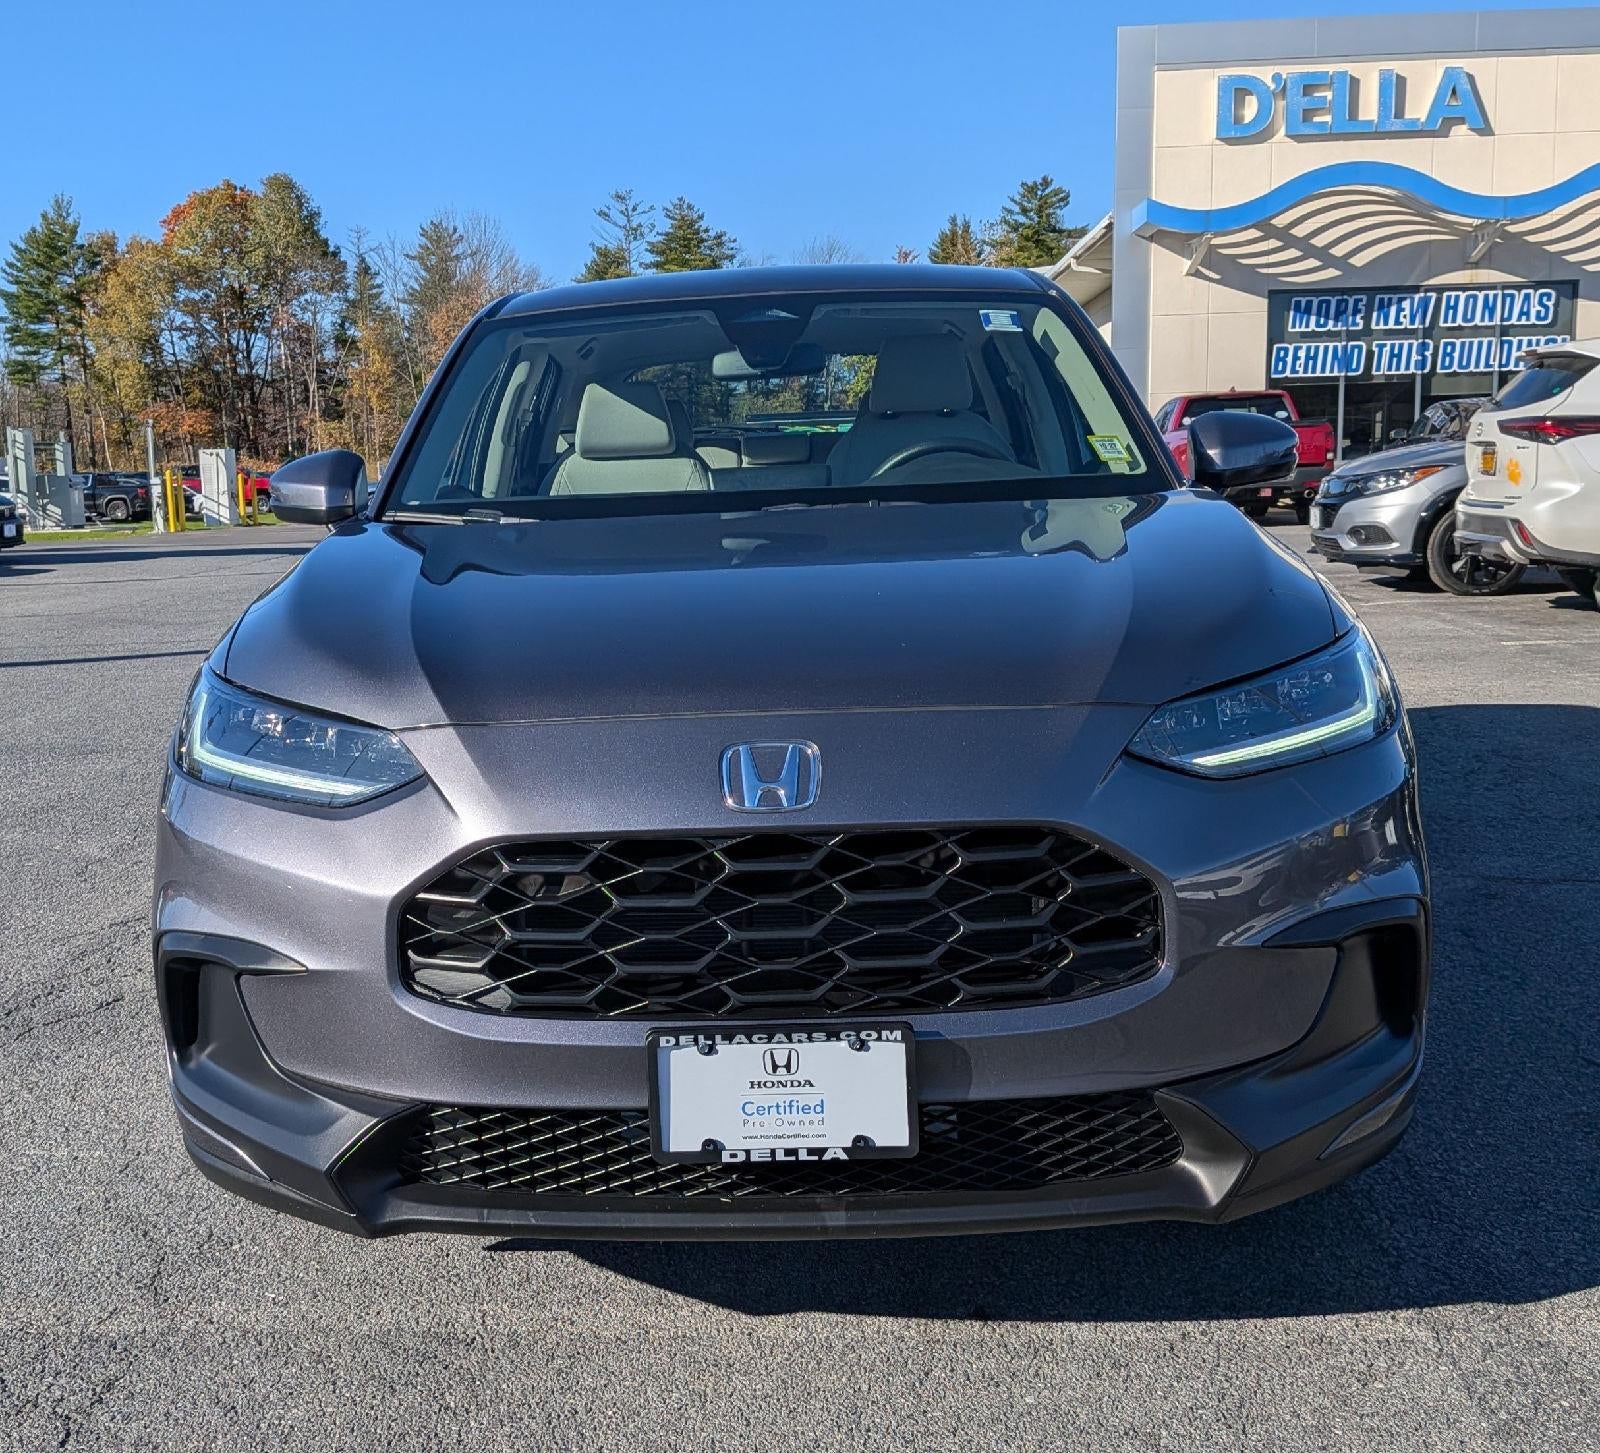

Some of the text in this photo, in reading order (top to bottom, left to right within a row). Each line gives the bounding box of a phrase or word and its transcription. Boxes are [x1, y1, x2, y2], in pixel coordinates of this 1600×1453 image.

[1216, 66, 1485, 139] D'ELLA
[1288, 289, 1555, 331] MORE NEW HONDAS
[1271, 336, 1570, 377] BEHIND THIS BUILDI
[660, 1030, 902, 1047] DELLACARS.COM
[749, 1079, 815, 1089] HONDA
[741, 1098, 824, 1116] Certified
[722, 1147, 849, 1162] DELLA
